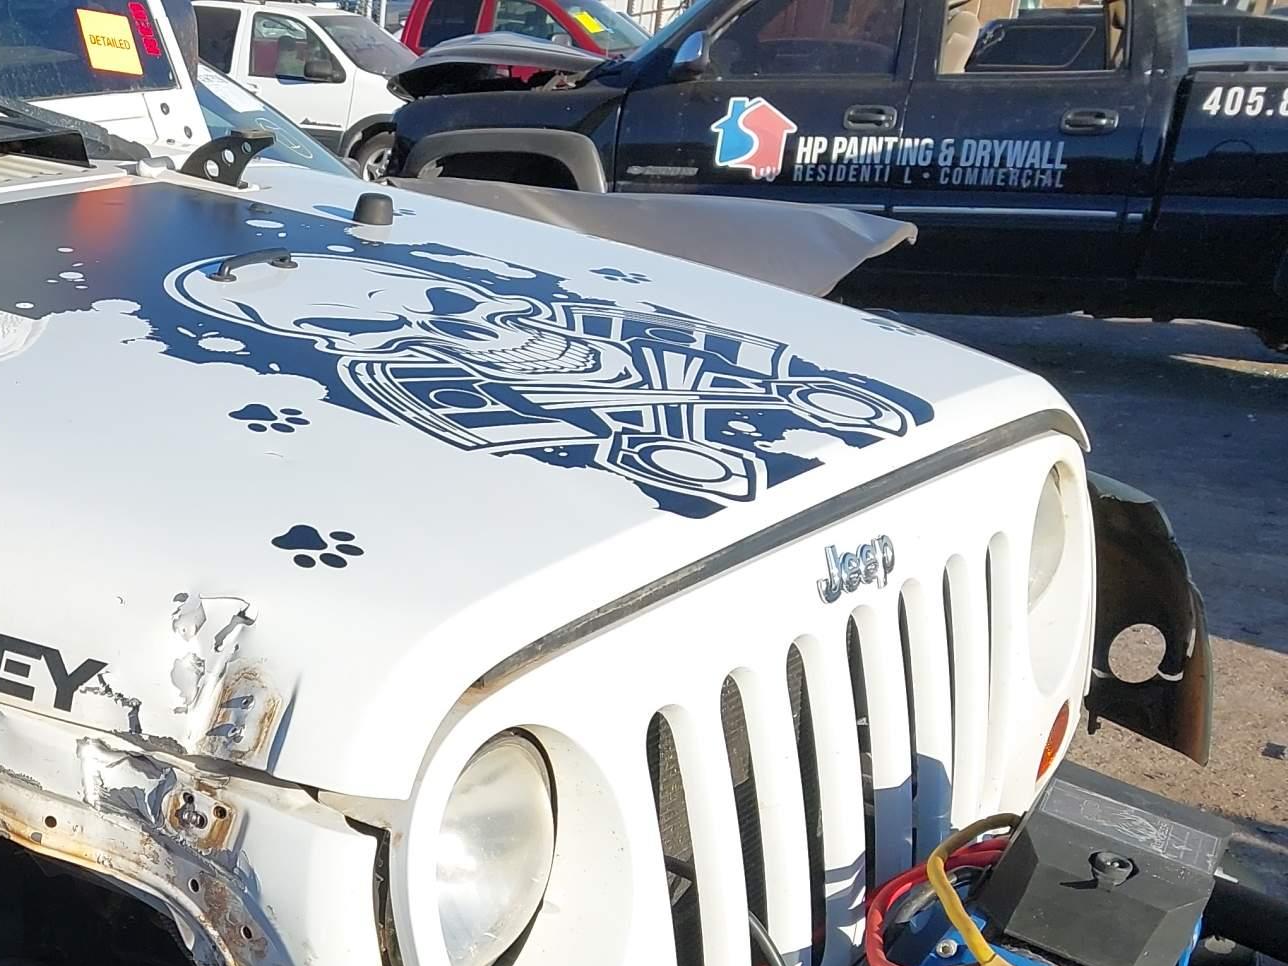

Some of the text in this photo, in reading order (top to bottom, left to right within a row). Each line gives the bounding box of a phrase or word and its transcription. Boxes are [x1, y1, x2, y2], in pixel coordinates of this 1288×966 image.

[89, 34, 131, 50] DETAILED
[796, 136, 1067, 169] HP PAINTING & DRYWALL
[793, 164, 1064, 188] RESIDENTIL COMMERCIAL
[816, 534, 895, 604] Jeep
